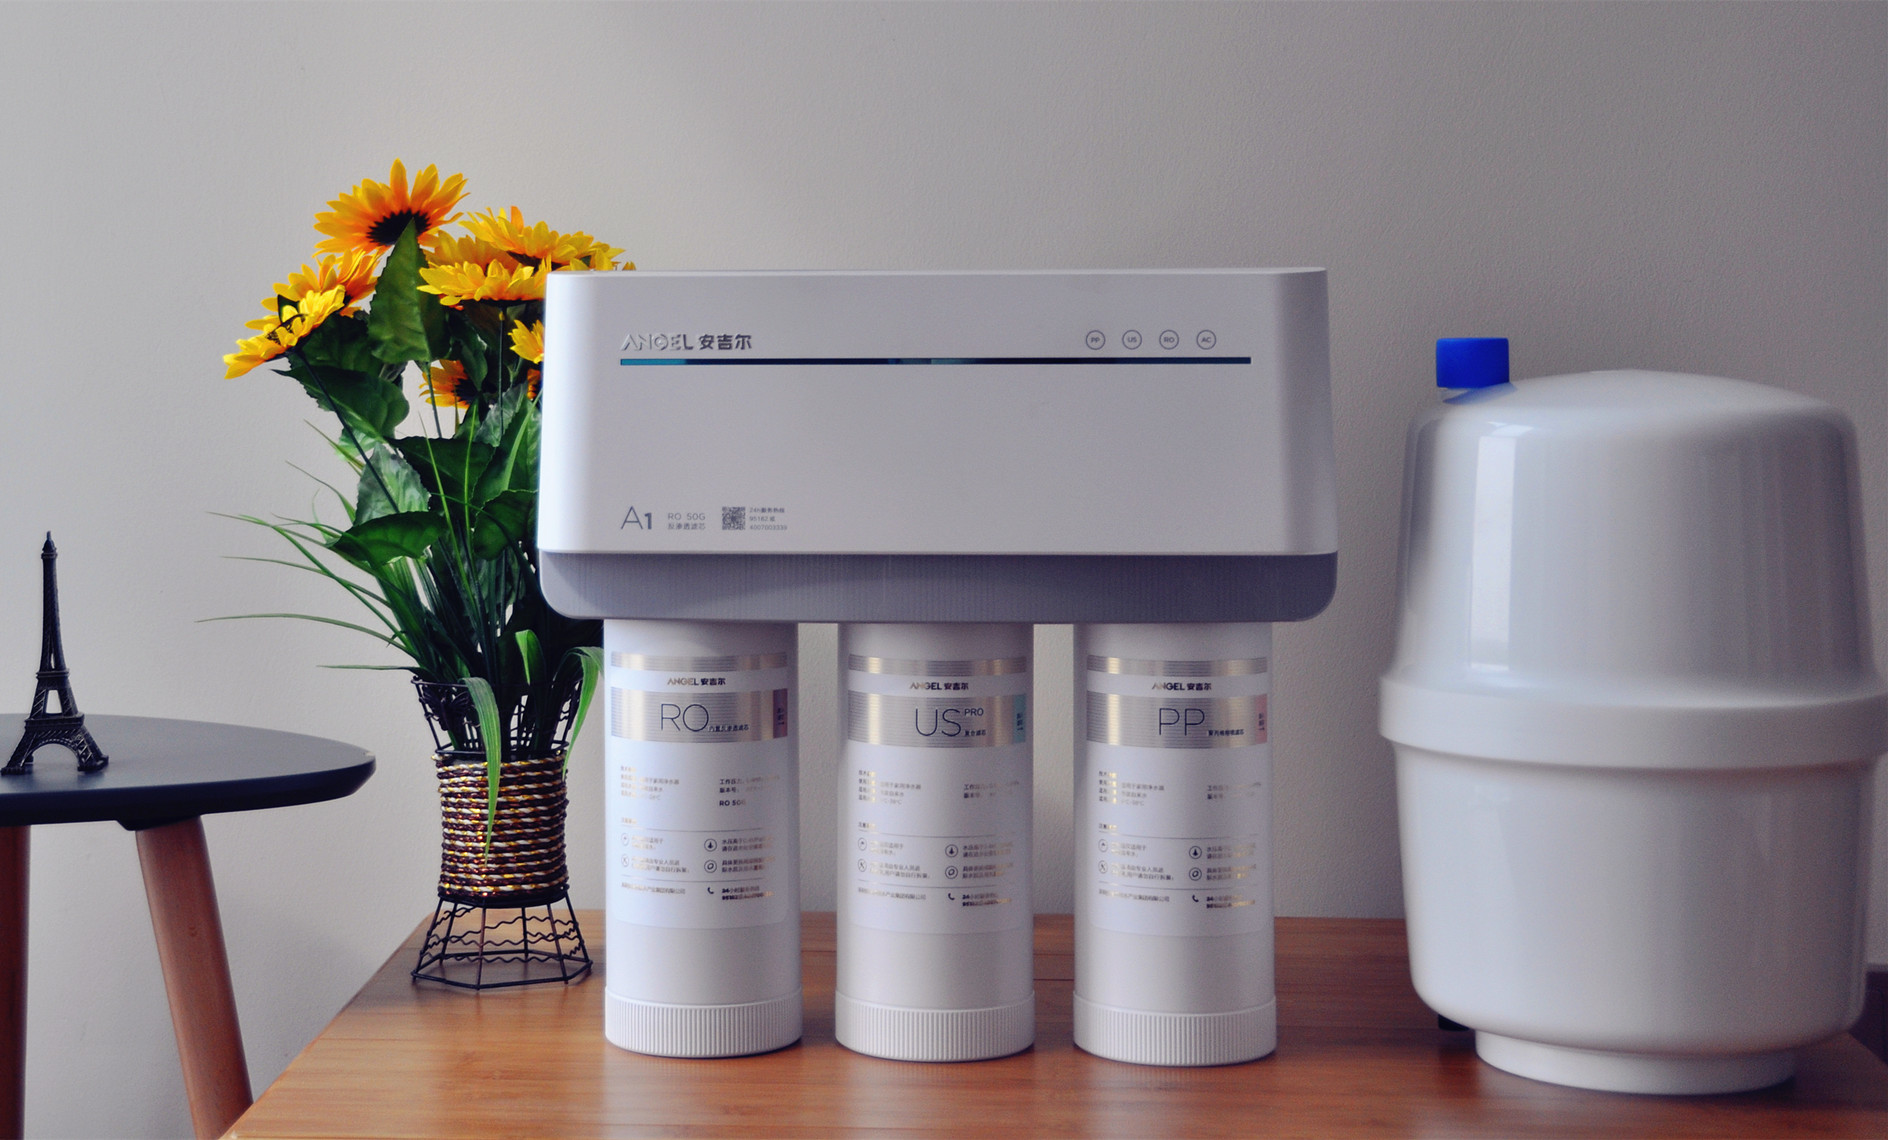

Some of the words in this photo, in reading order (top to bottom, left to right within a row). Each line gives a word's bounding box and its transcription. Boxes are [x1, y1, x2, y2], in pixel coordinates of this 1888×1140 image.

[620, 333, 694, 351] ANGEL
[698, 333, 753, 351] 安吉尔
[1090, 336, 1101, 344] PP
[1127, 336, 1138, 344] US
[1163, 336, 1175, 344] RO
[1200, 336, 1212, 344] AC
[620, 505, 653, 530] A1
[667, 512, 682, 521] RO
[686, 512, 706, 521] 50G
[667, 677, 699, 686] ANGEL
[700, 677, 727, 686] 安吉尔
[909, 682, 943, 691] ANGEL
[943, 682, 969, 691] 安吉尔
[1152, 682, 1185, 691] ANGEL
[1186, 682, 1212, 691] 安吉尔
[964, 708, 984, 717] PRO
[660, 703, 710, 732] RO
[915, 707, 962, 737] US
[1158, 707, 1206, 736] PP
[719, 799, 730, 807] RO
